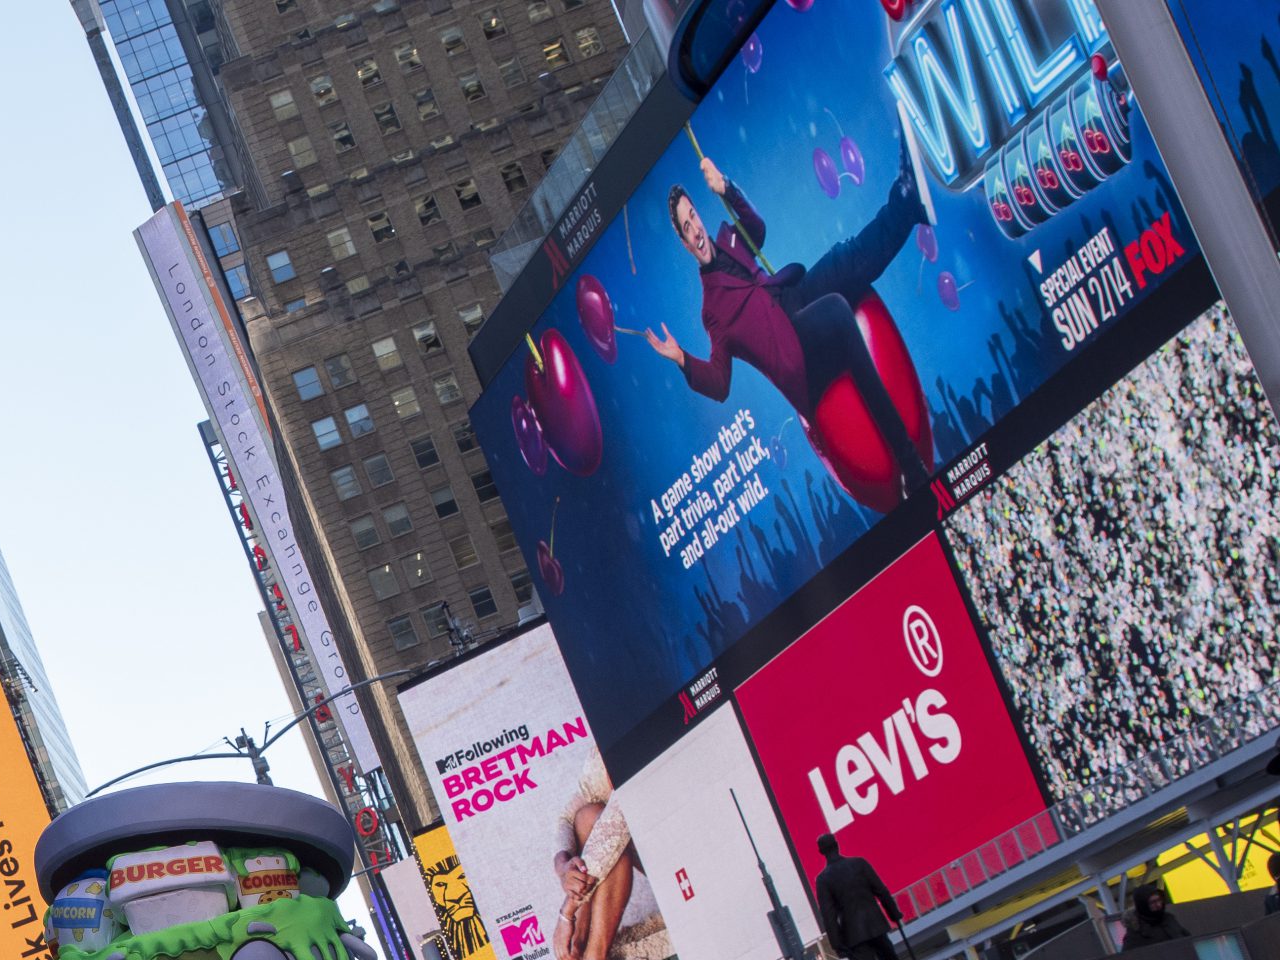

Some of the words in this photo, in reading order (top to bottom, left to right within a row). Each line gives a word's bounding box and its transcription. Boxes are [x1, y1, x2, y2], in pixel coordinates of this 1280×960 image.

[882, 0, 1113, 185] WIL
[559, 182, 598, 239] MARRIOTT
[566, 208, 602, 258] MARQUIS
[1040, 255, 1085, 308] SPECIAL
[1078, 226, 1115, 274] EVENT
[1052, 287, 1099, 351] SUN
[1088, 256, 1134, 322] 2/14
[1124, 210, 1185, 289] FOX
[168, 263, 216, 368] London
[217, 380, 256, 461] Stock
[319, 629, 359, 717] Group
[651, 498, 665, 525] A
[661, 472, 694, 518] game
[691, 442, 722, 484] show
[717, 409, 755, 454] that's
[946, 442, 989, 483] MARRIOTT
[952, 462, 991, 499] MARQUIS
[659, 515, 686, 557] part
[680, 490, 718, 531] trivia,
[712, 460, 742, 505] part
[735, 436, 771, 476] luck,
[680, 531, 705, 570] and
[701, 500, 740, 550] all-out
[736, 473, 769, 515] wild.
[689, 666, 718, 697] MARRIOTT
[694, 683, 721, 711] MARQUIS
[441, 716, 588, 799] BRETMAN
[454, 724, 530, 767] Following
[451, 768, 538, 823] ROCK
[110, 854, 225, 890] BURGER
[241, 872, 299, 890] COOKIES
[495, 904, 533, 924] STREAMING
